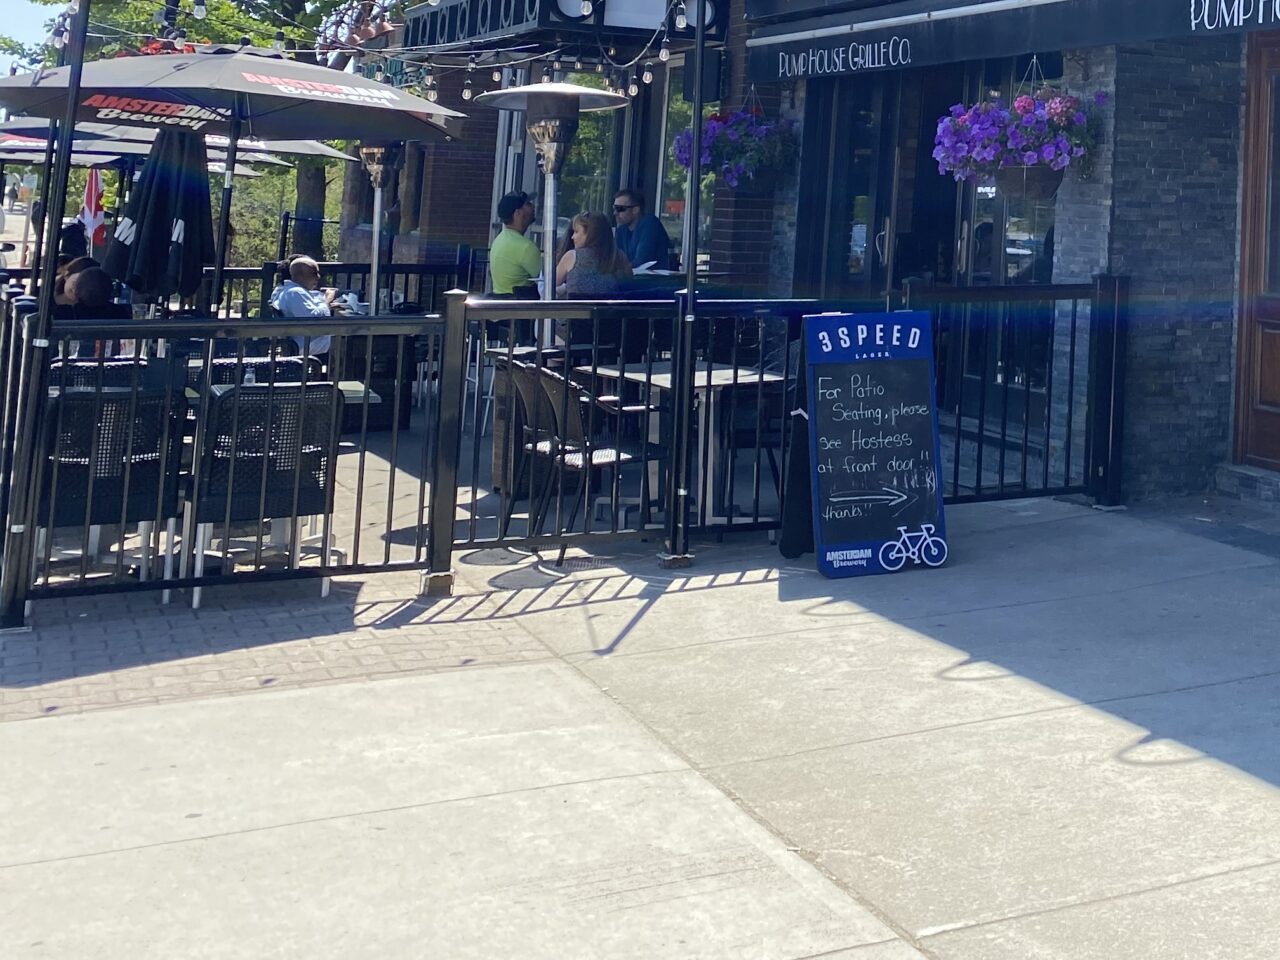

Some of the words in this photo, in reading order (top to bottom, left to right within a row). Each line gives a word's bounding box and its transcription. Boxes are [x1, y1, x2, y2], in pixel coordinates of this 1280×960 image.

[778, 52, 807, 78] PUMP
[808, 47, 846, 75] HOUSE
[848, 41, 887, 71] GRILLE
[889, 36, 912, 66] CO.
[241, 72, 400, 101] AMSTERDAM
[272, 84, 395, 108] Brewery
[96, 108, 208, 130] Brewery
[838, 324, 921, 349] SPEED
[818, 377, 842, 401] For
[851, 374, 885, 398] Patio
[891, 402, 930, 426] please
[851, 429, 913, 451] Hostess
[817, 458, 834, 473] at
[842, 455, 877, 473] front
[826, 548, 872, 562] AMSTERDAM
[832, 559, 867, 568] Brewery
